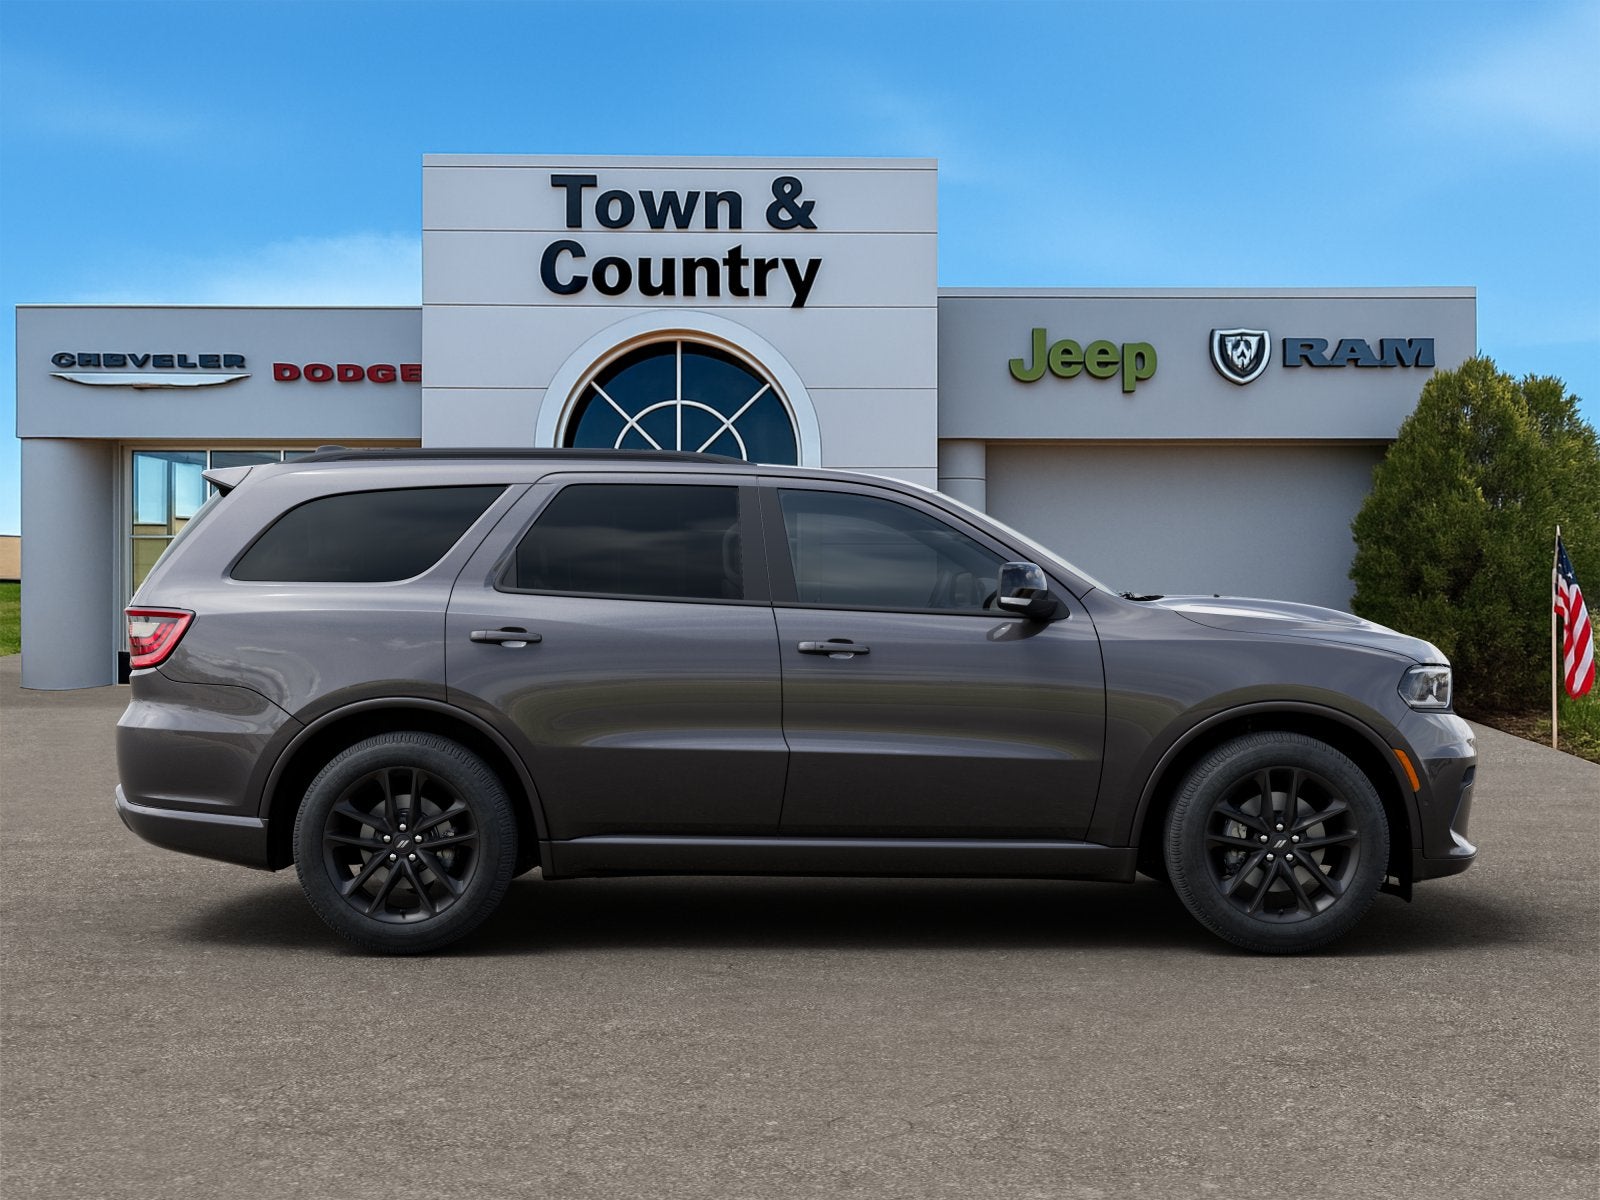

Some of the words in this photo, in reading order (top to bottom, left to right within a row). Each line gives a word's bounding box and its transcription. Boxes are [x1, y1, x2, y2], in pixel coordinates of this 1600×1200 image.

[551, 174, 742, 229] Town
[765, 176, 818, 230] &
[540, 239, 822, 308] Country
[273, 363, 422, 382] DODGE
[1009, 327, 1158, 393] Jeep
[1282, 338, 1435, 367] RAM
